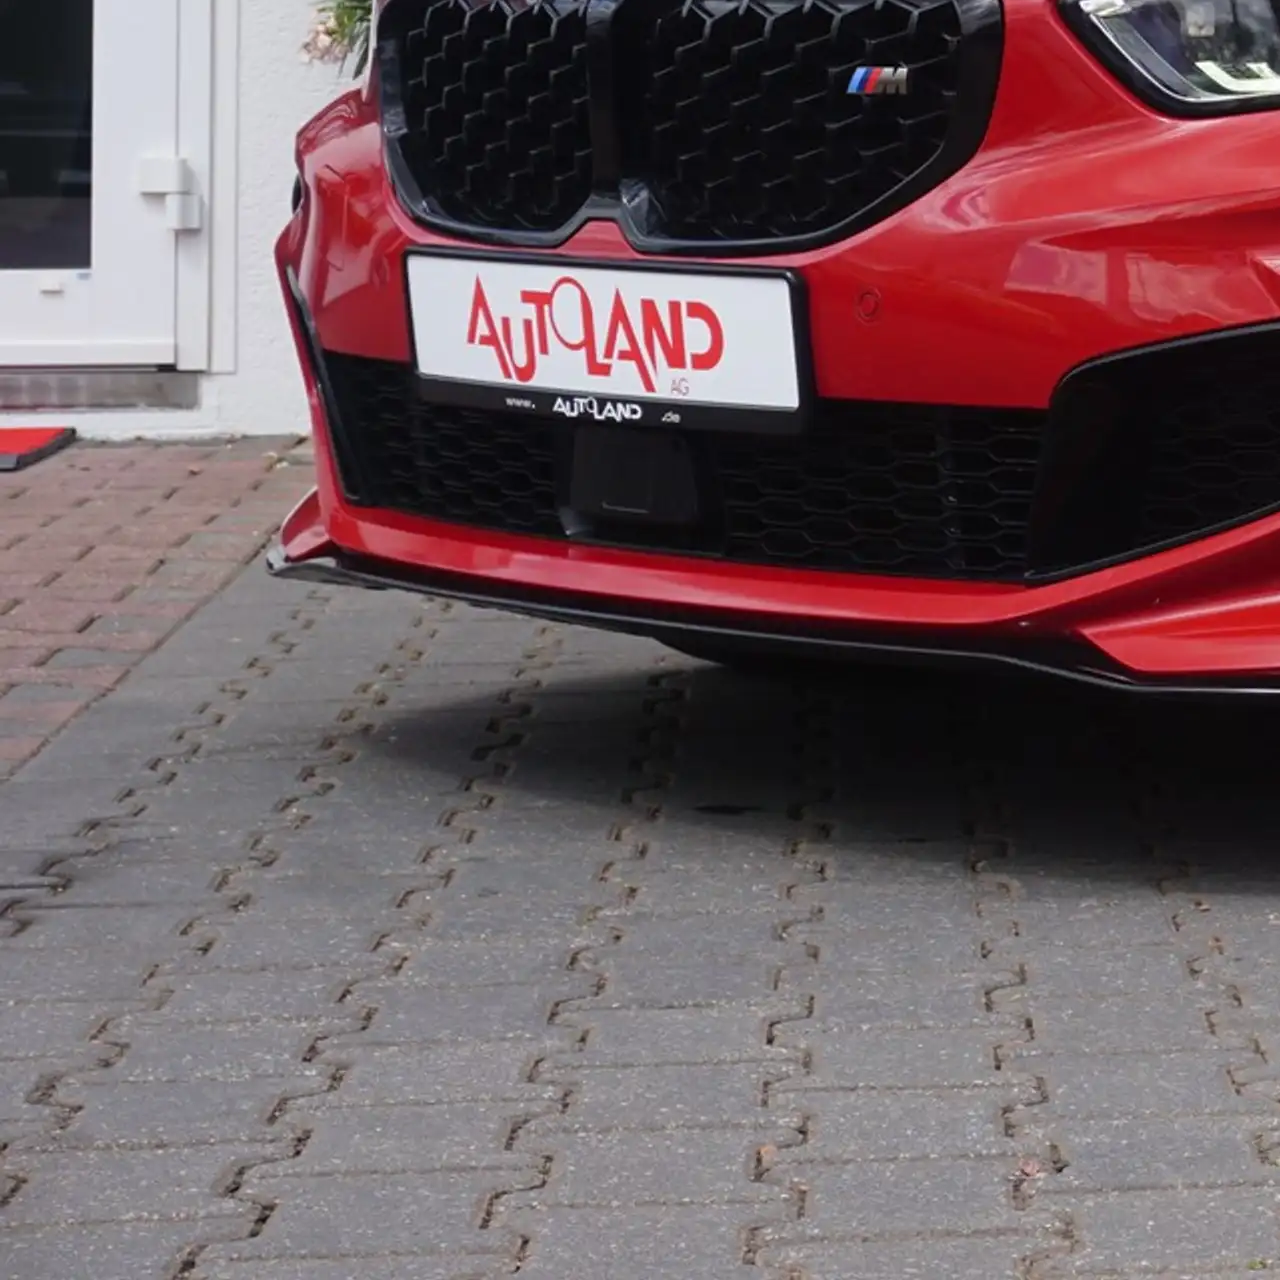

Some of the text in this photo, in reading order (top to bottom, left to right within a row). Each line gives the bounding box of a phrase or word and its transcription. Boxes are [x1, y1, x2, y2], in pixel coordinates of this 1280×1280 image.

[467, 274, 724, 392] AUTOLAND
[670, 378, 689, 396] AG
[552, 396, 643, 423] AUTOLAND
